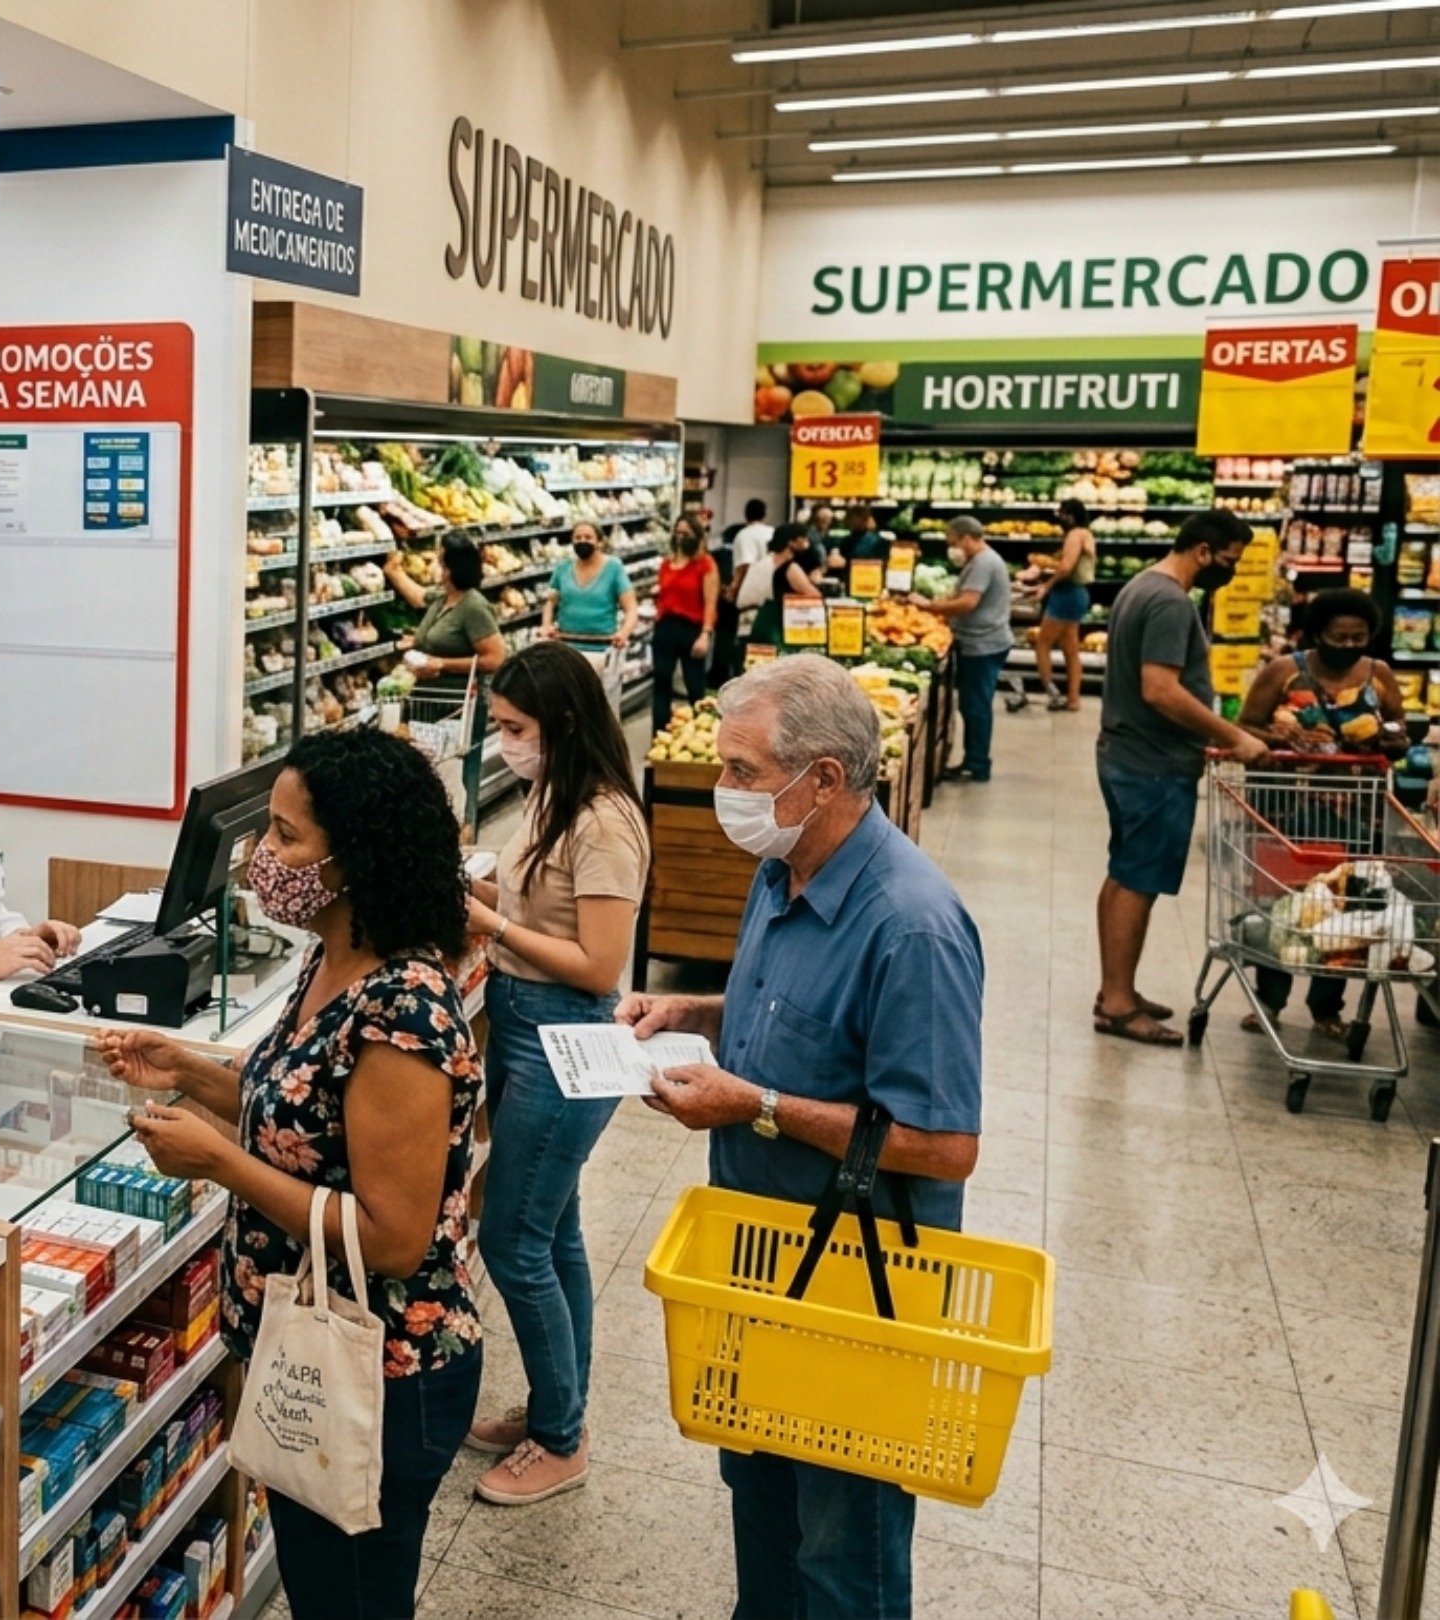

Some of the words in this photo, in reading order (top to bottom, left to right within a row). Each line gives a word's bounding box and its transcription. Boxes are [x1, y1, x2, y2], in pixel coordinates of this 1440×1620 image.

[249, 177, 323, 230] ENTREGA
[233, 217, 357, 277] MEDICAMENTOS
[444, 114, 676, 341] SUPERMERCADO
[811, 249, 1369, 315] SUPERMERCADO
[1211, 337, 1348, 367] OFERTAS
[16, 379, 147, 410] SEMANA
[922, 372, 1180, 412] HORTIFRUTI
[805, 459, 839, 490] 13
